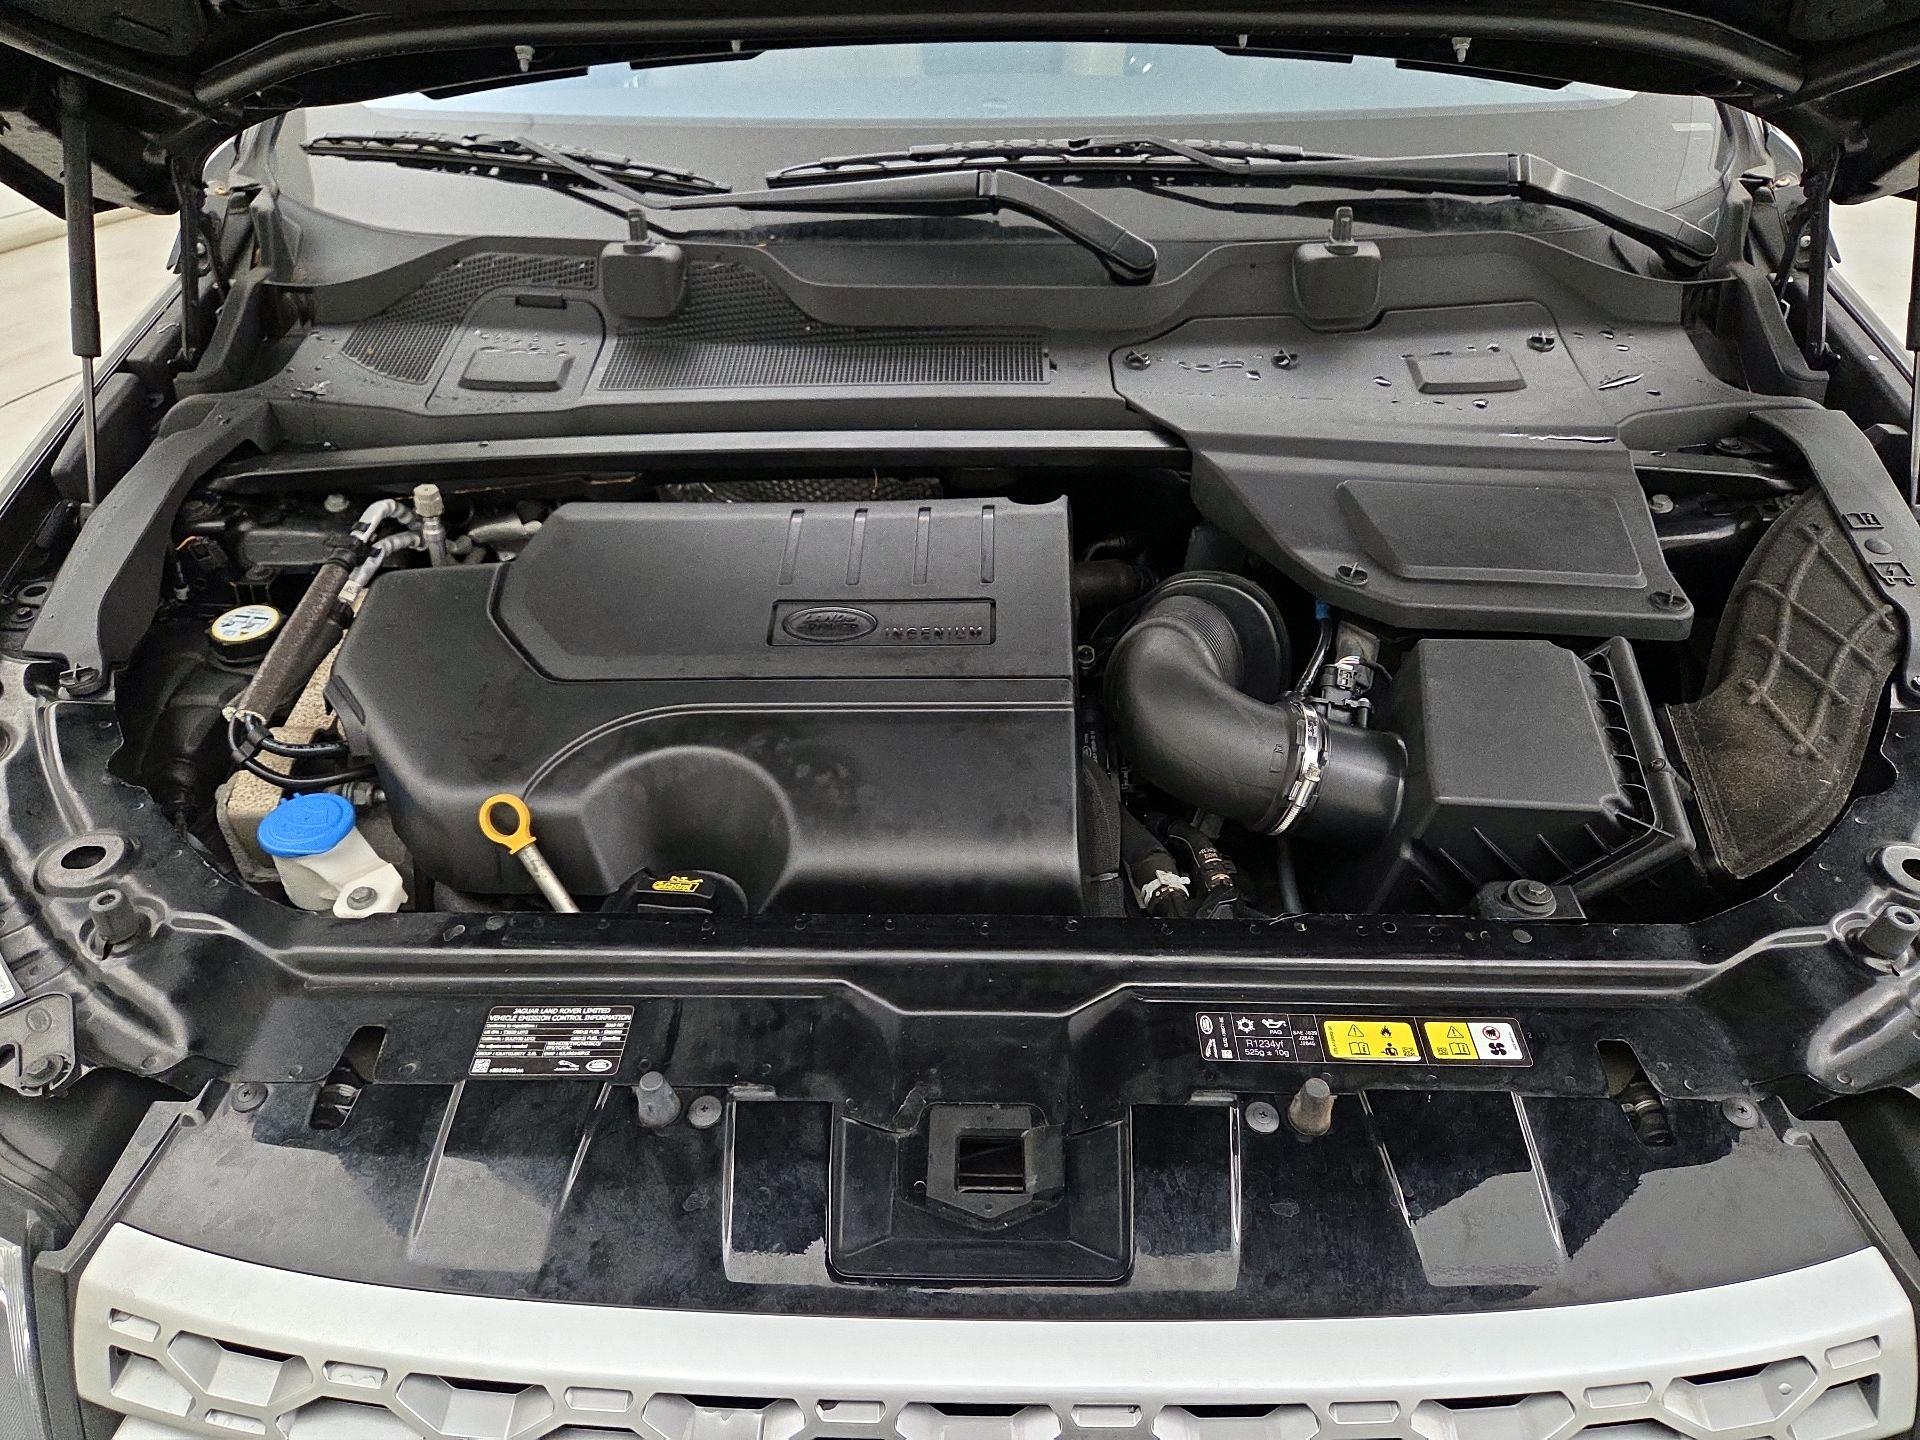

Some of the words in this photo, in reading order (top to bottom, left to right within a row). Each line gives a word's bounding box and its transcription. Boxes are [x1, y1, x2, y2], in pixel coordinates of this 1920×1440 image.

[884, 626, 984, 642] INGENIUM
[1245, 1039, 1284, 1049] R1234yf
[1244, 1049, 1265, 1057] 525g
[1275, 1049, 1290, 1058] 10g
